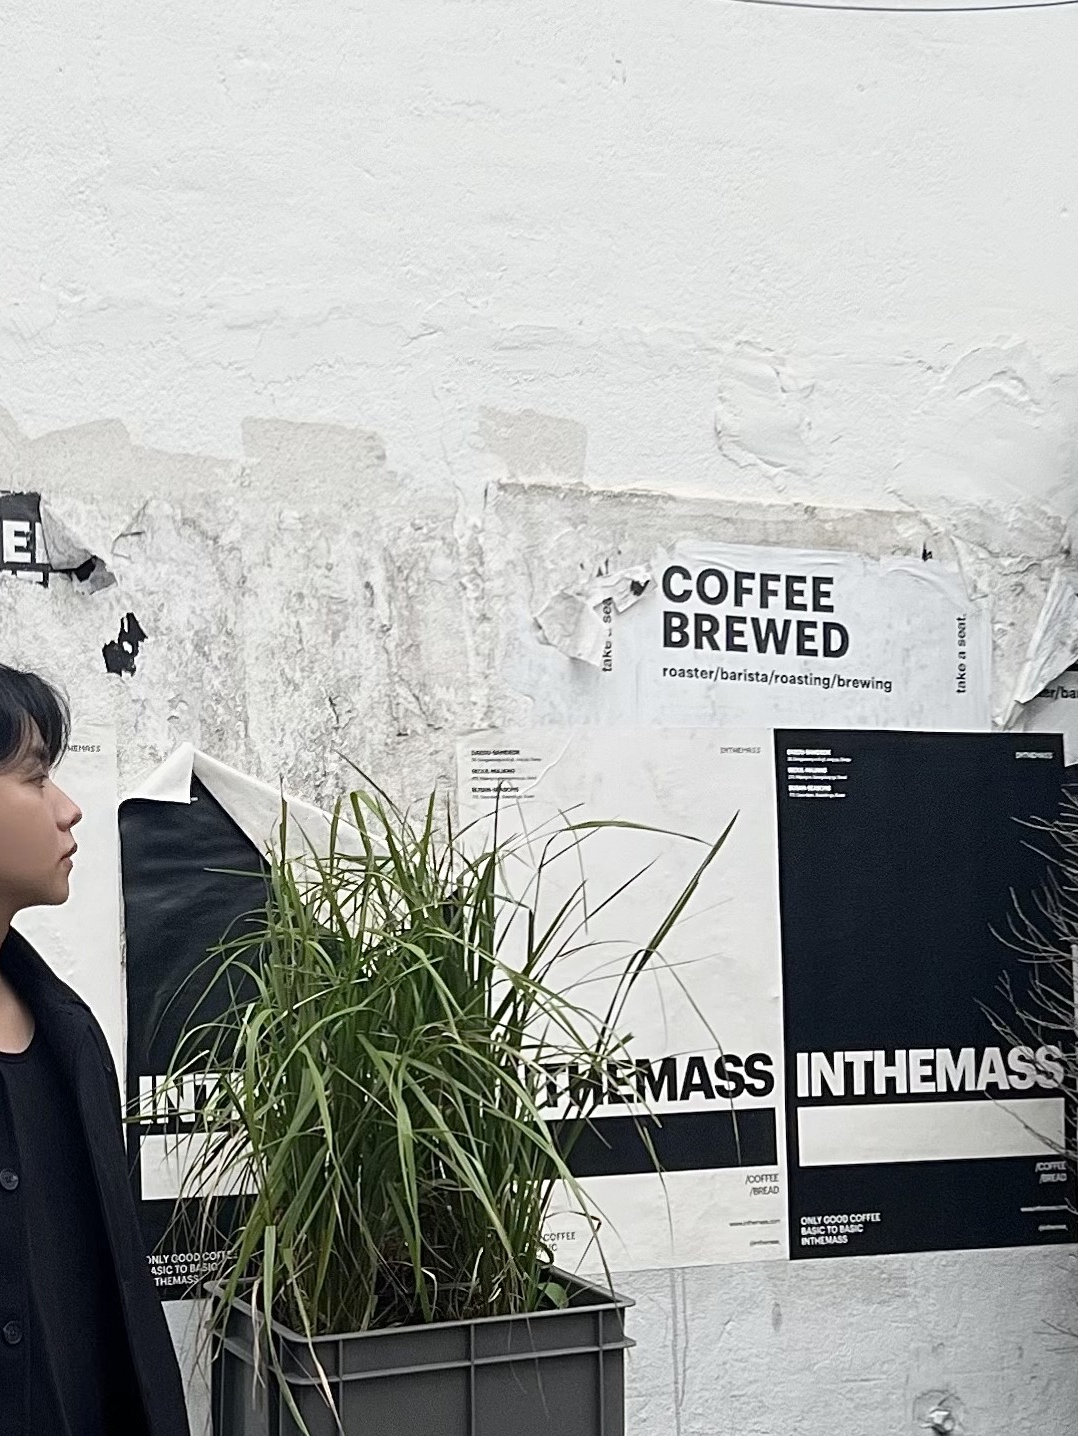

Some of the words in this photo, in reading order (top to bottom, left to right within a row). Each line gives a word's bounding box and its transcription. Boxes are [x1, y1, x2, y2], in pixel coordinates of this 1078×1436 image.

[662, 565, 834, 613] COFFEE
[662, 611, 849, 658] BREWED
[662, 664, 893, 692] roaster/barista/roasting/brewing
[955, 663, 966, 693] take
[797, 1045, 1064, 1097] INTHEMASS
[745, 1173, 779, 1184] /COFFEE
[801, 1216, 822, 1225] ONLY
[823, 1215, 848, 1224] GOOD
[849, 1212, 881, 1222] COFFEE
[801, 1226, 825, 1235] BASIC
[826, 1225, 838, 1234] TO
[839, 1224, 863, 1233] BASIC
[171, 1253, 200, 1263] GOOD
[175, 1264, 187, 1273] TO
